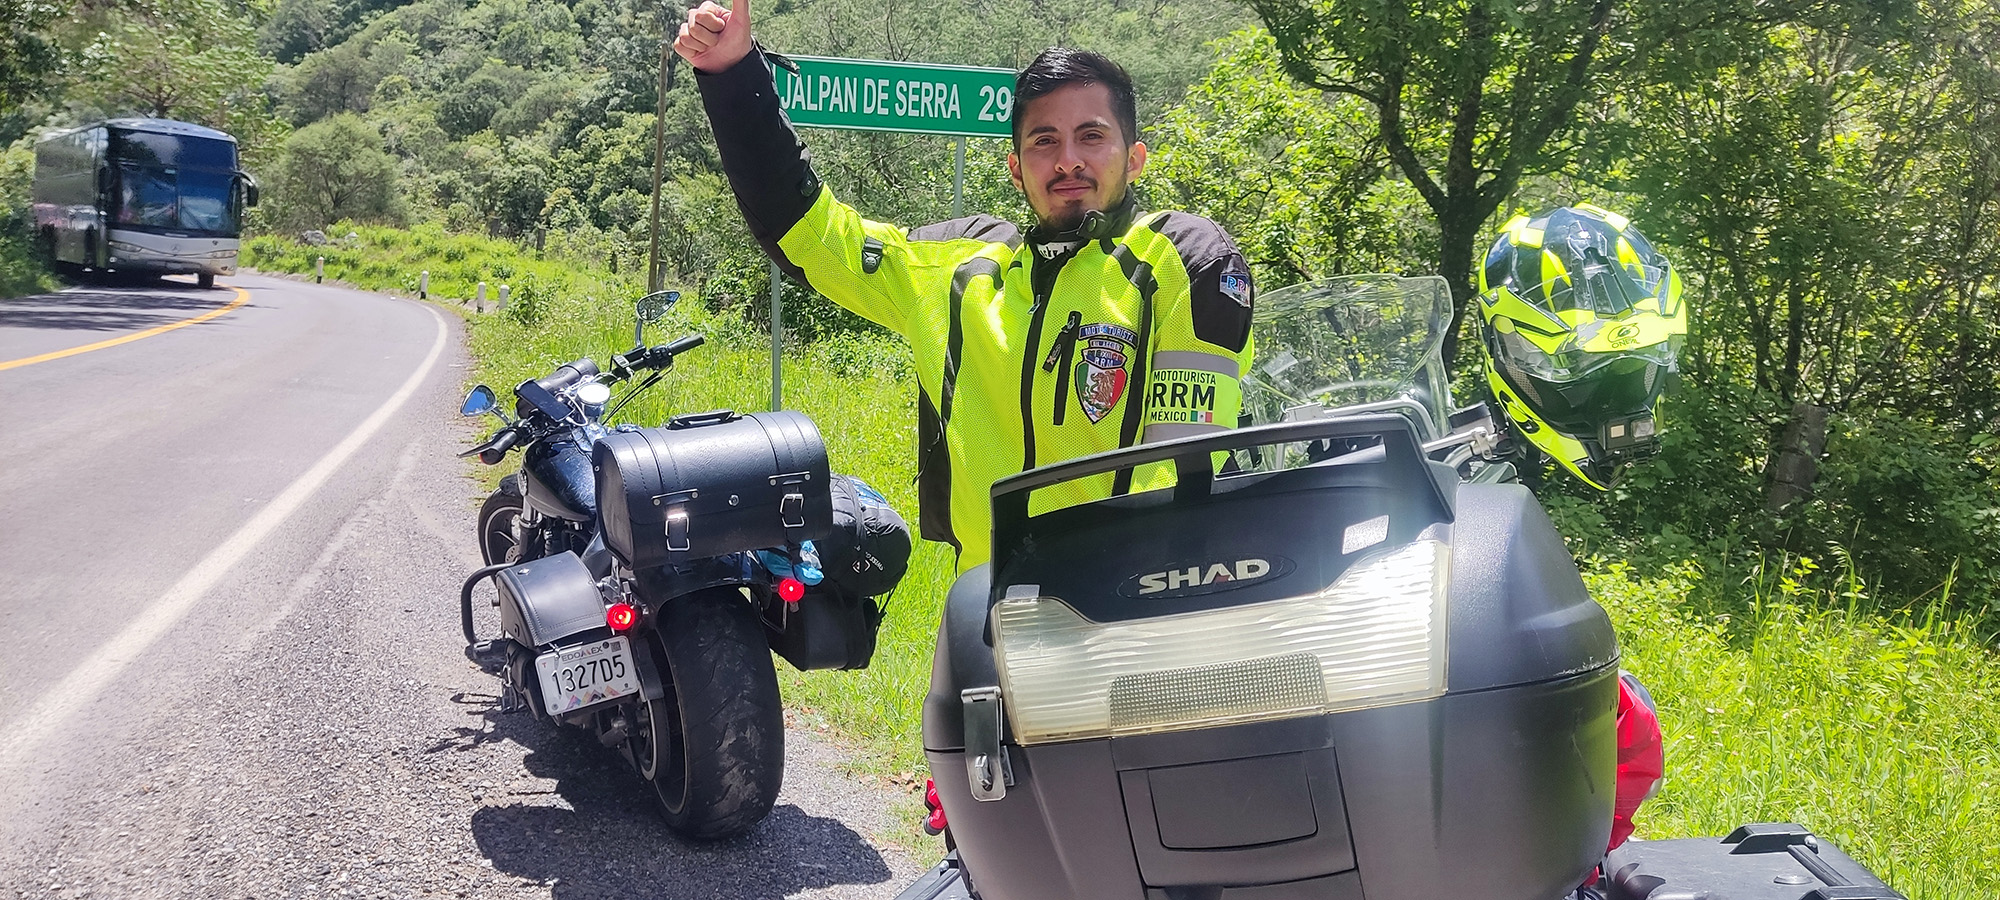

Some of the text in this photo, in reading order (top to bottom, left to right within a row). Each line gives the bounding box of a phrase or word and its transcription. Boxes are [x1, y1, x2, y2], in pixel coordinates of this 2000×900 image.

[781, 73, 1013, 122] JALPAN DE SERRA 29
[1153, 370, 1217, 385] MOTOTURISTA
[1151, 382, 1216, 411] RRM
[1138, 558, 1271, 595] SHAD
[551, 654, 626, 696] 1327D5
